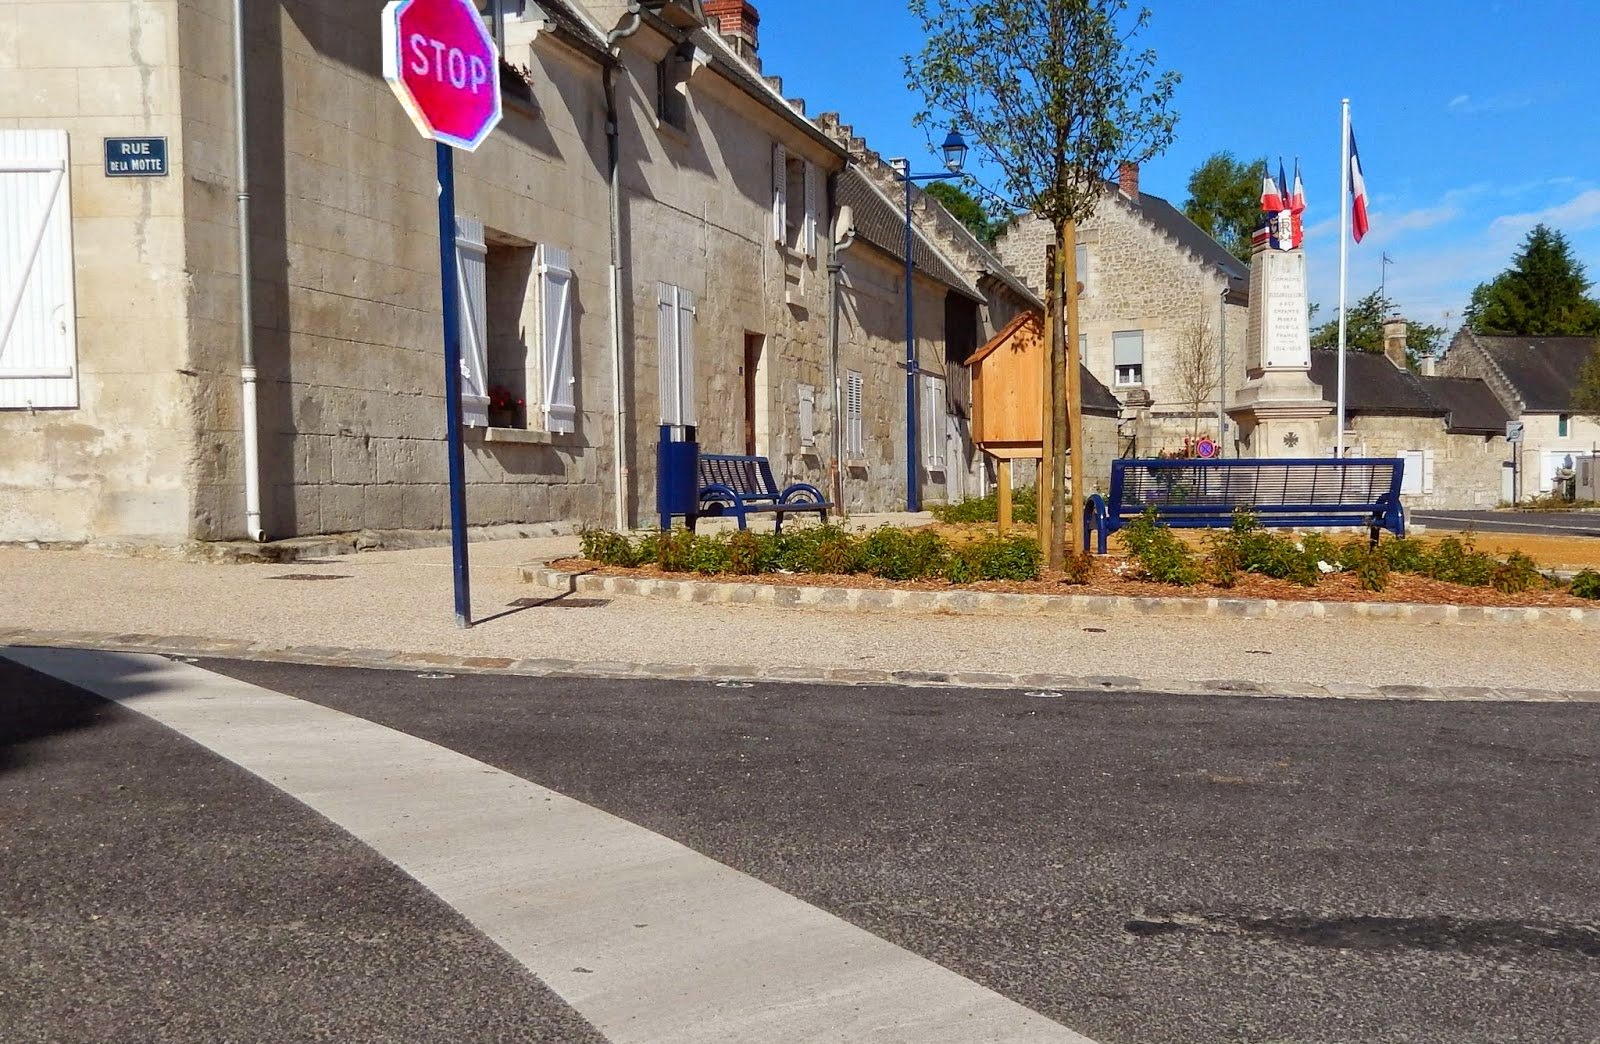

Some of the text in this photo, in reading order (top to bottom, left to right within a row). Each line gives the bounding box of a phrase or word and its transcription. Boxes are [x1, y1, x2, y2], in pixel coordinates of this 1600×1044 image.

[410, 33, 487, 94] STOP
[121, 143, 150, 155] RUE
[110, 159, 162, 171] DE LA MOTTE
